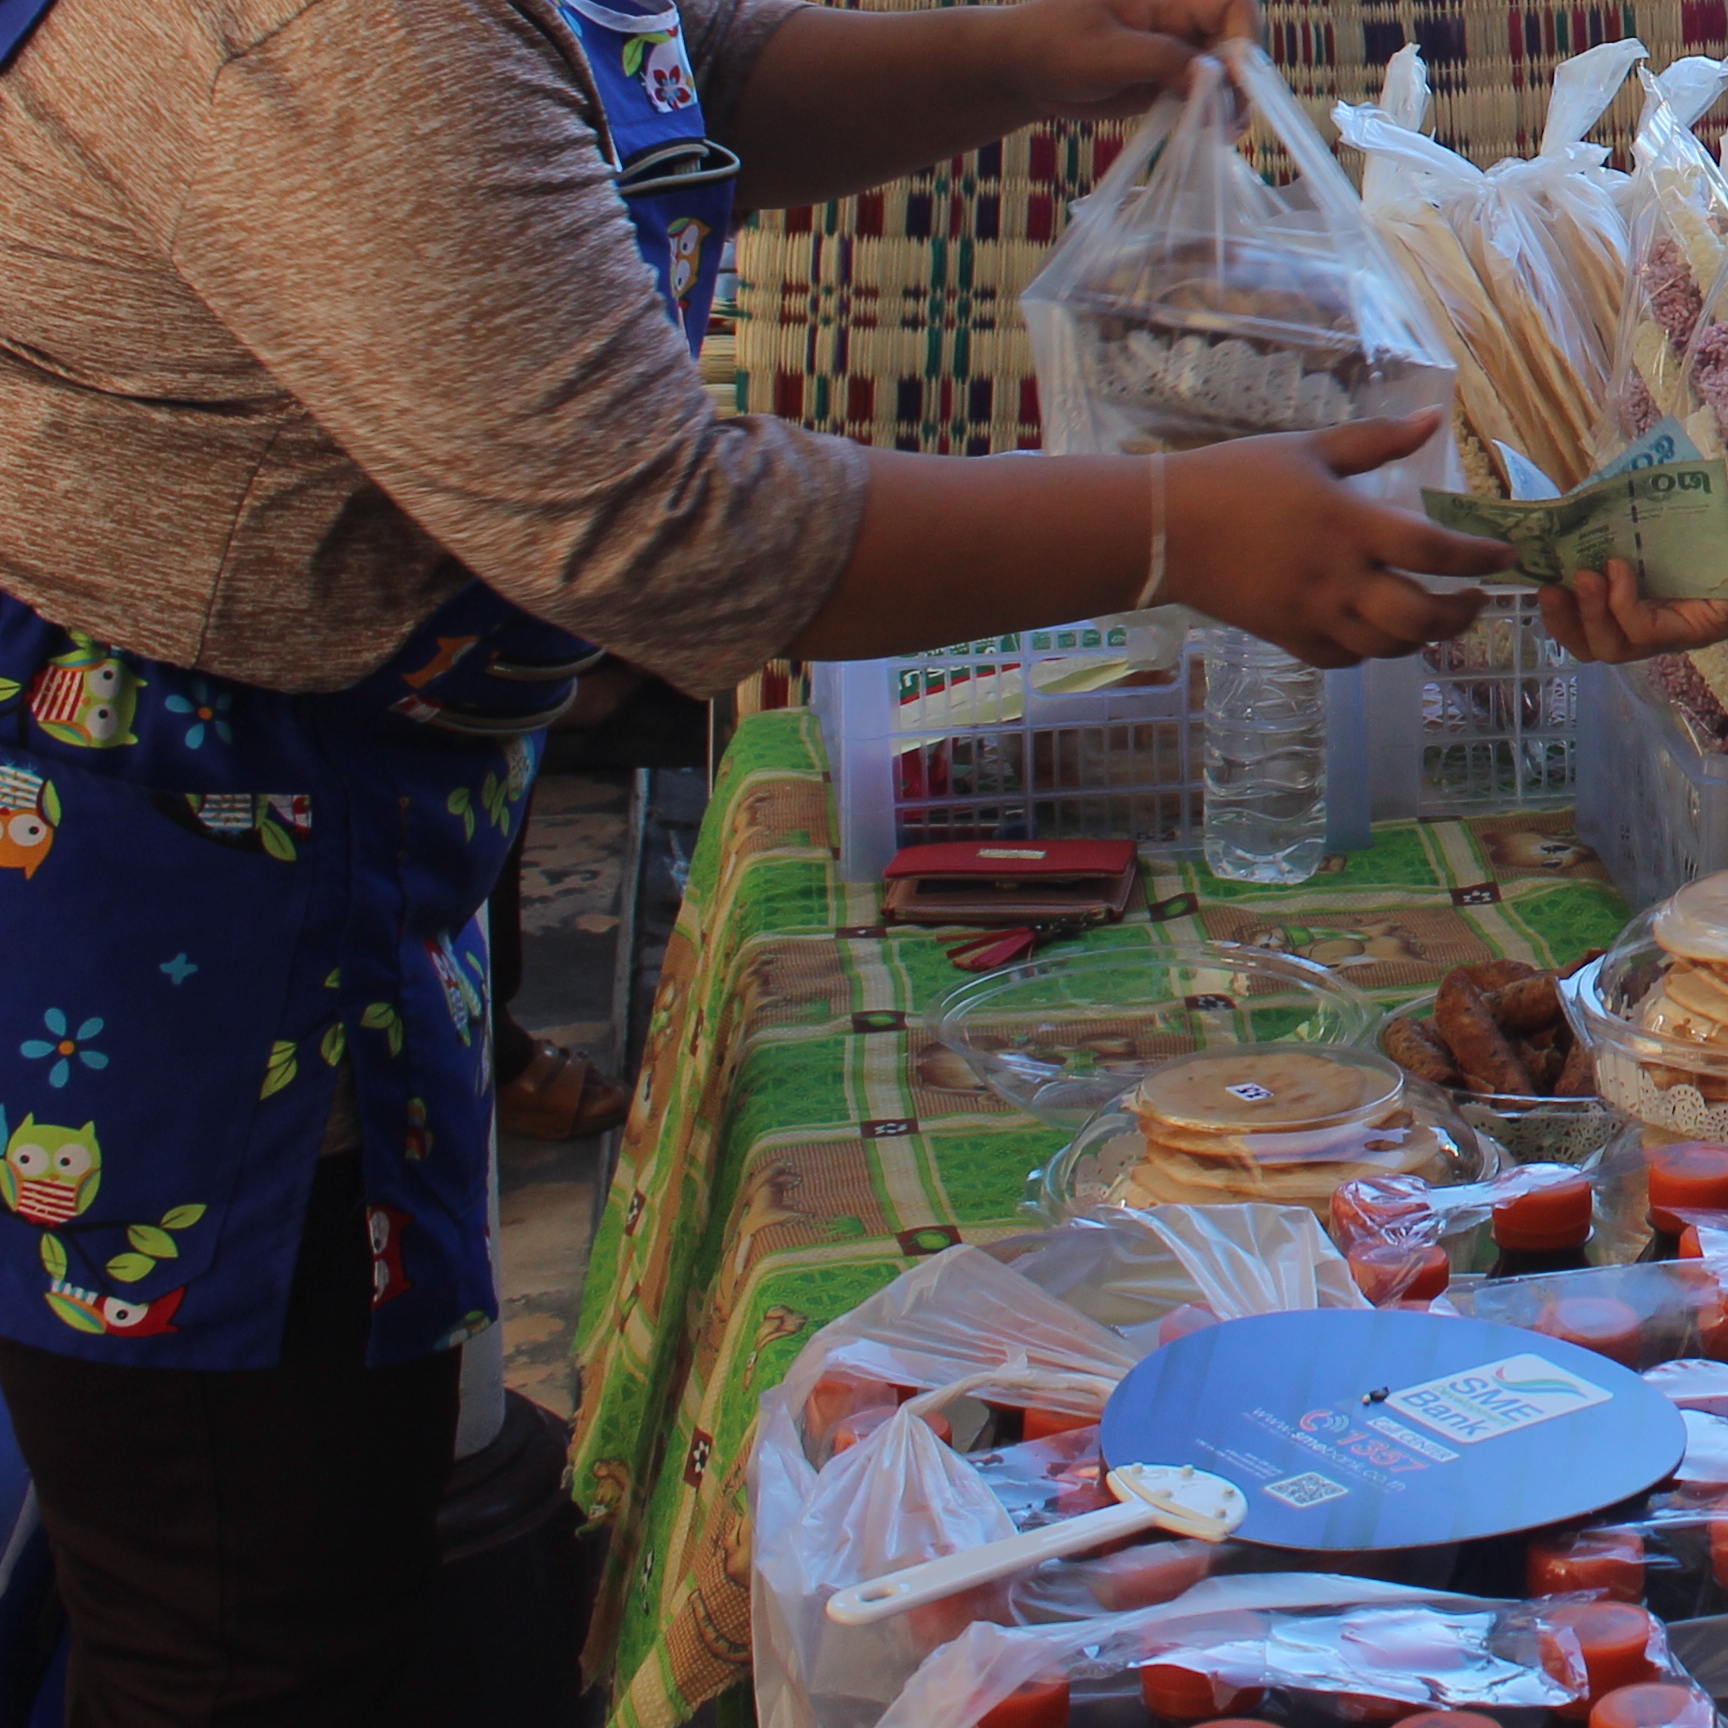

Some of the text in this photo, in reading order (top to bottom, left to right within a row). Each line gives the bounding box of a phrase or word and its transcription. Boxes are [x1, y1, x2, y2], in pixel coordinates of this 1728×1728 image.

[1650, 471, 1712, 494] ๒๐
[1400, 1390, 1490, 1436] Bank
[1447, 1376, 1545, 1422] SME
[1251, 1406, 1407, 1493] www.smebank.co.th
[1335, 1429, 1429, 1474] 1357
